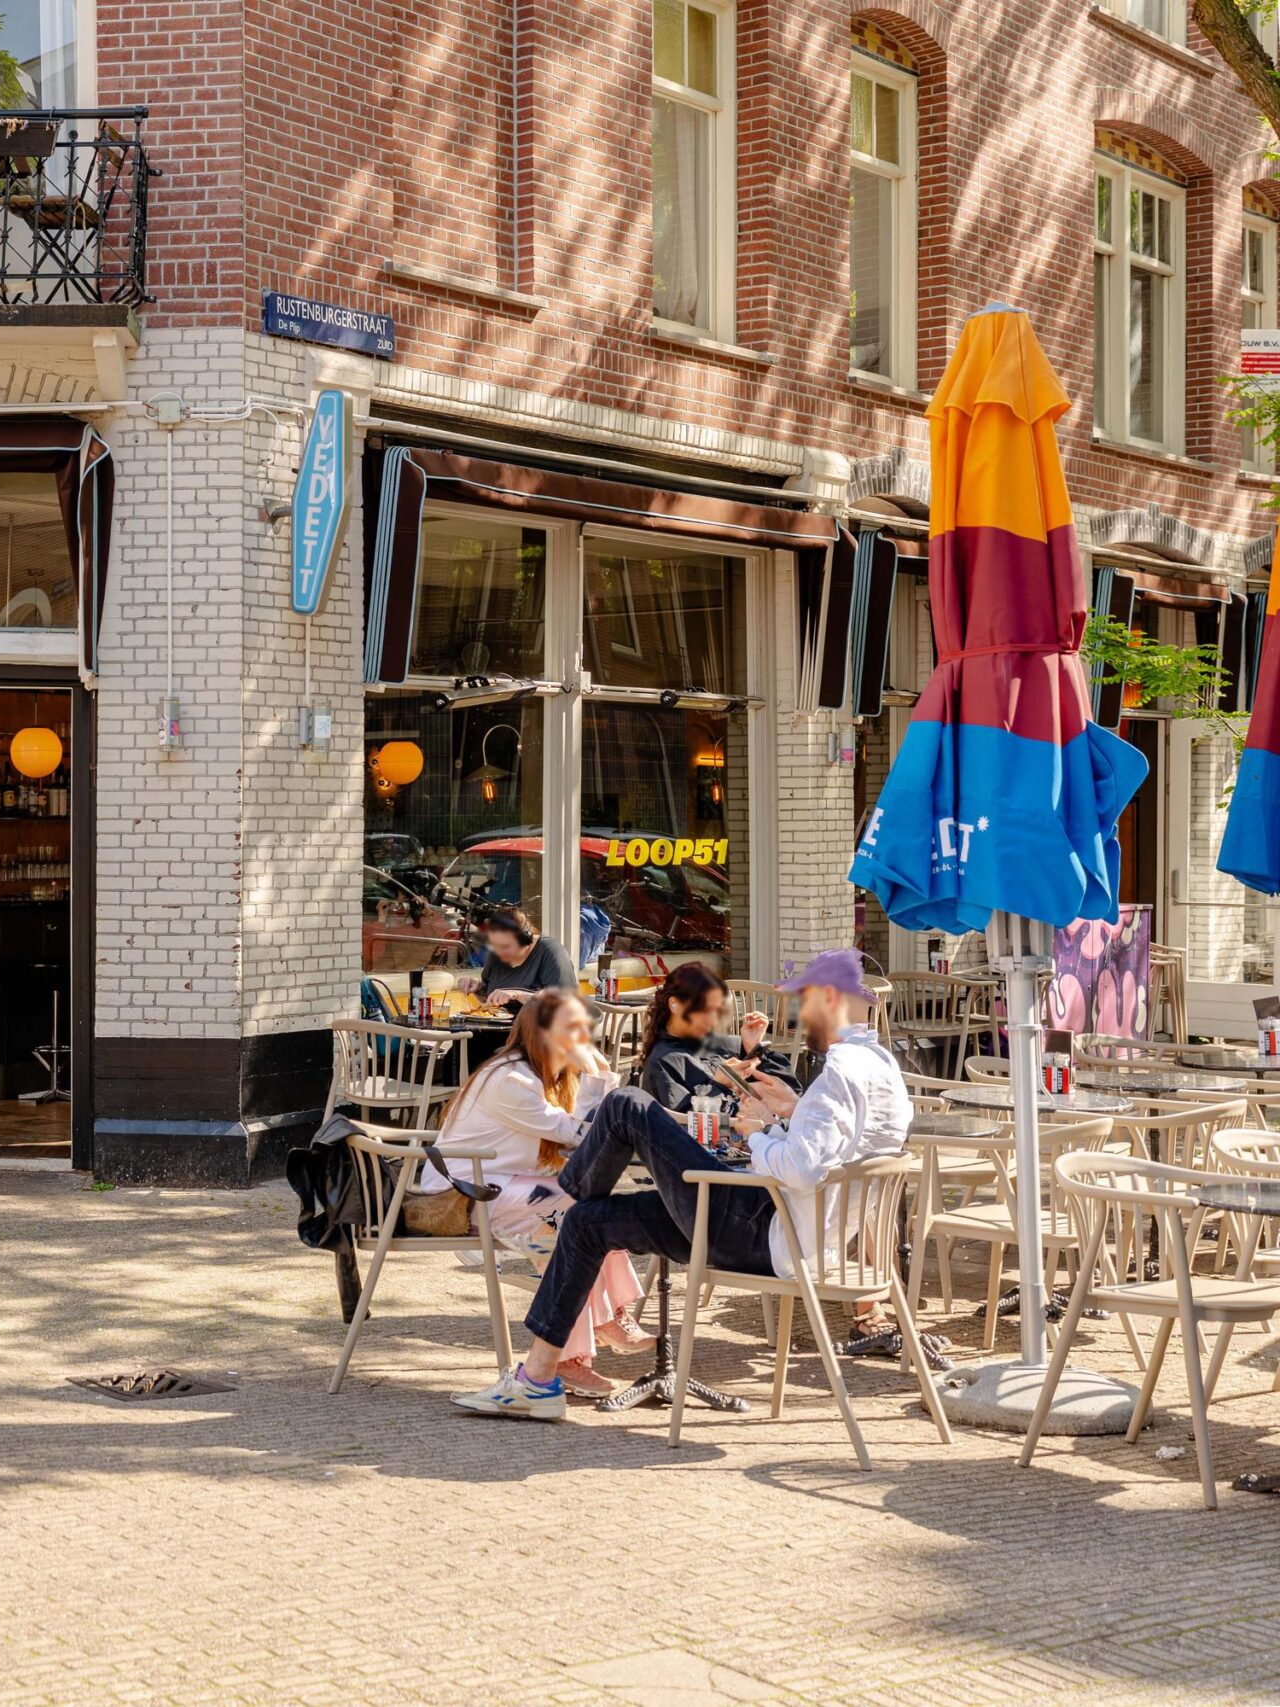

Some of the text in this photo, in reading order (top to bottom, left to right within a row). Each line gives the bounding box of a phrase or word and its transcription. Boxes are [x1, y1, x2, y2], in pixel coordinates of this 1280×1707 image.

[276, 296, 388, 336] RUSTENBURGERSTRAAT
[278, 318, 301, 334] De Pijp
[377, 340, 393, 351] ZUID
[299, 414, 333, 594] VEDETT
[606, 838, 729, 867] LOOP51
